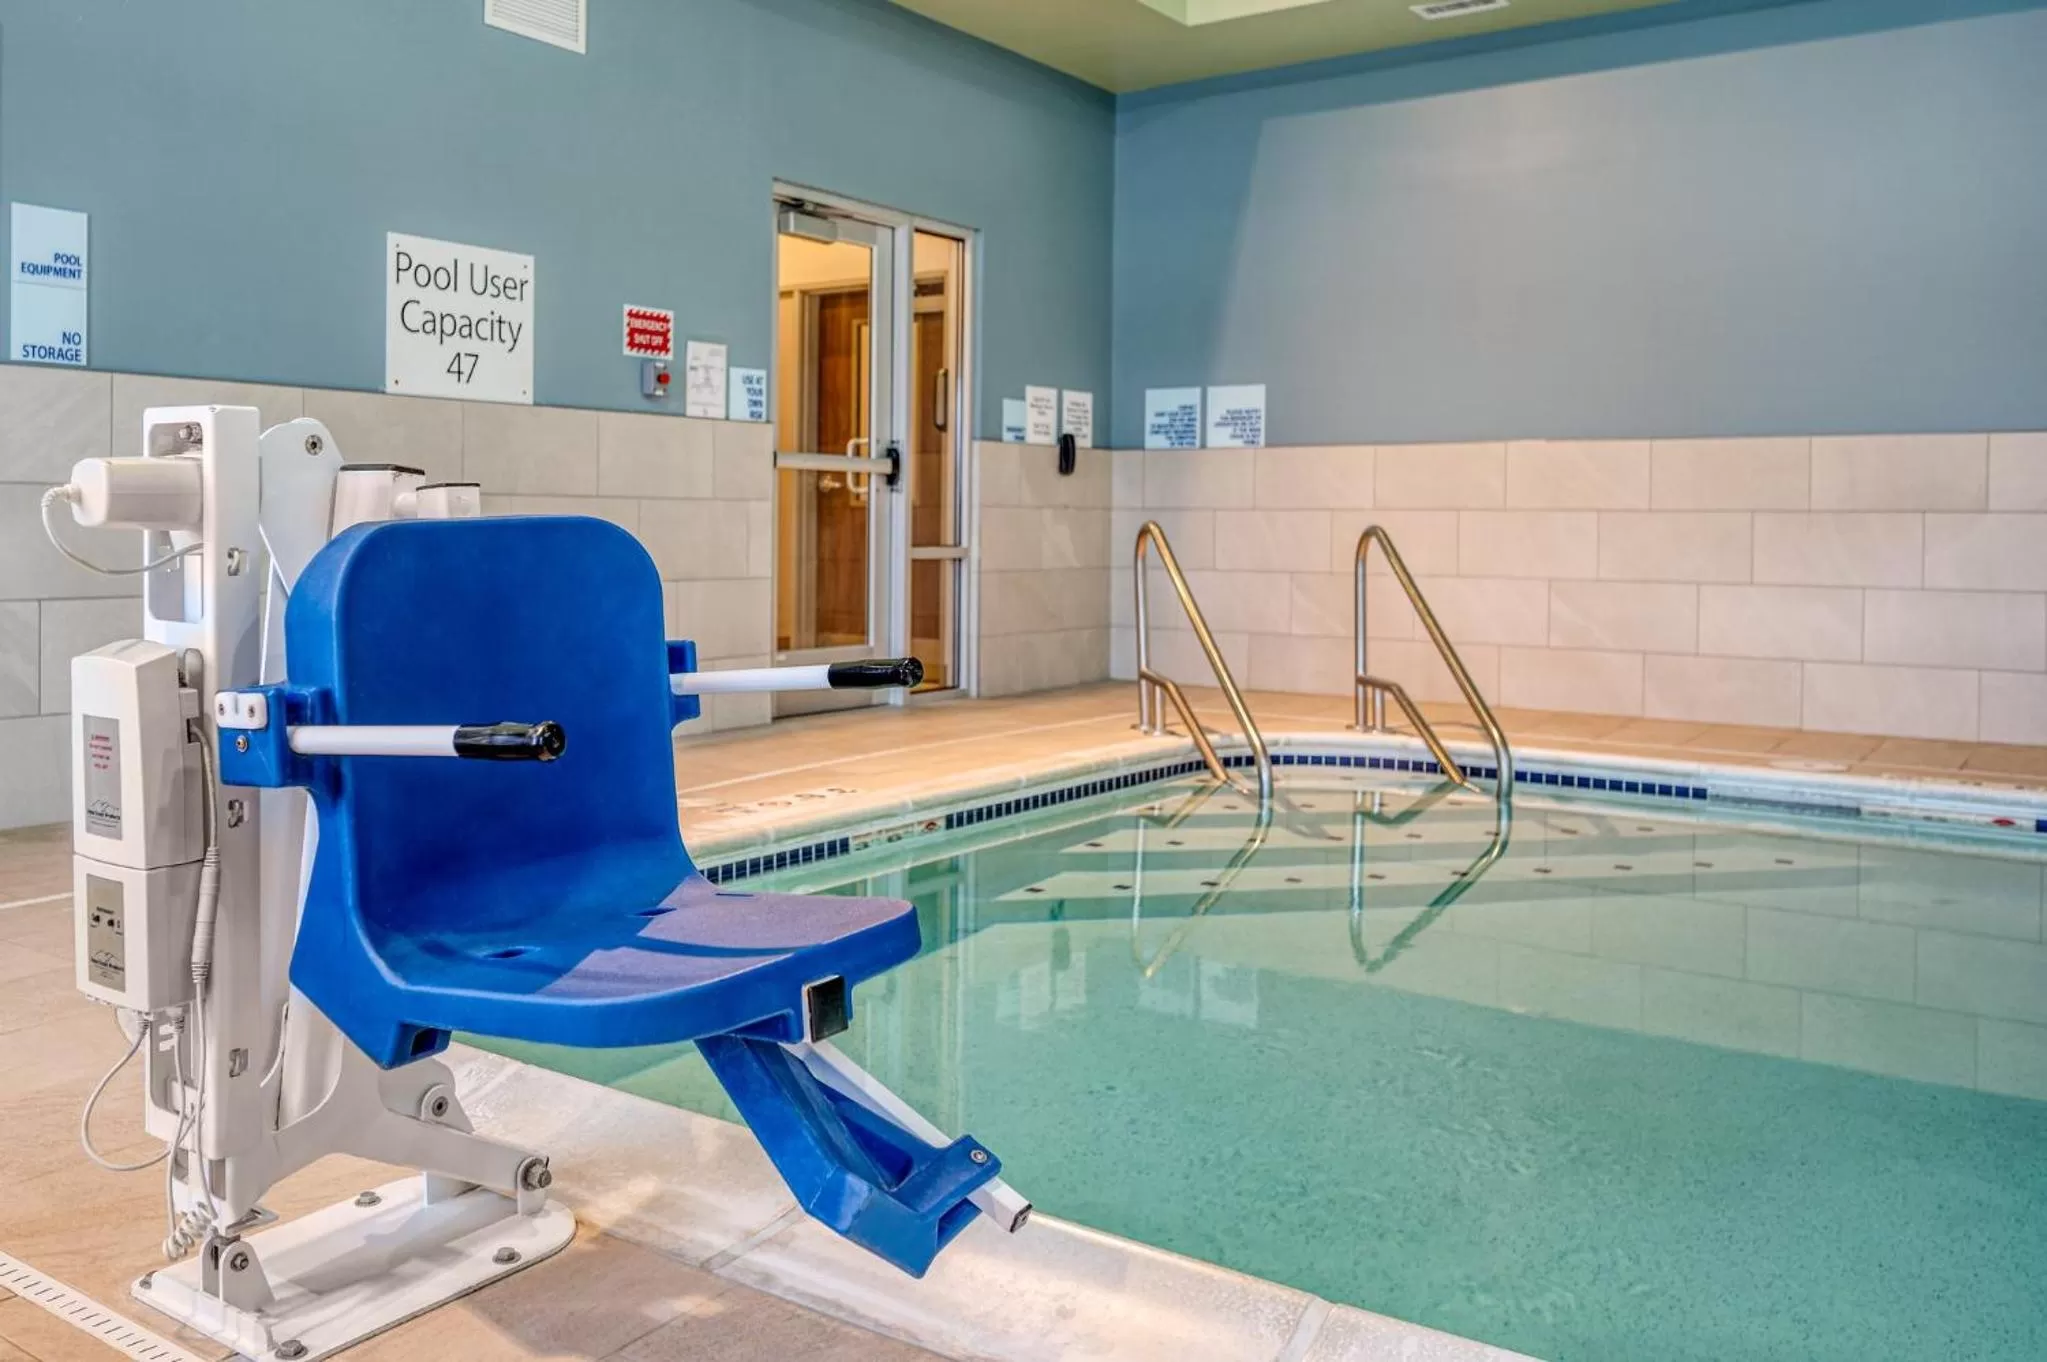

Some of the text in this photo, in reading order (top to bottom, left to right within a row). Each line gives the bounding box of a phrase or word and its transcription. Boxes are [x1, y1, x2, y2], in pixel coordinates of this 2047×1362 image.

[53, 252, 82, 267] POOL
[21, 261, 82, 280] EQUIPMENT
[396, 251, 529, 302] Pool User
[400, 299, 523, 353] Capacity
[62, 331, 82, 346] NO
[22, 344, 82, 362] STORAGE
[446, 352, 480, 384] 47
